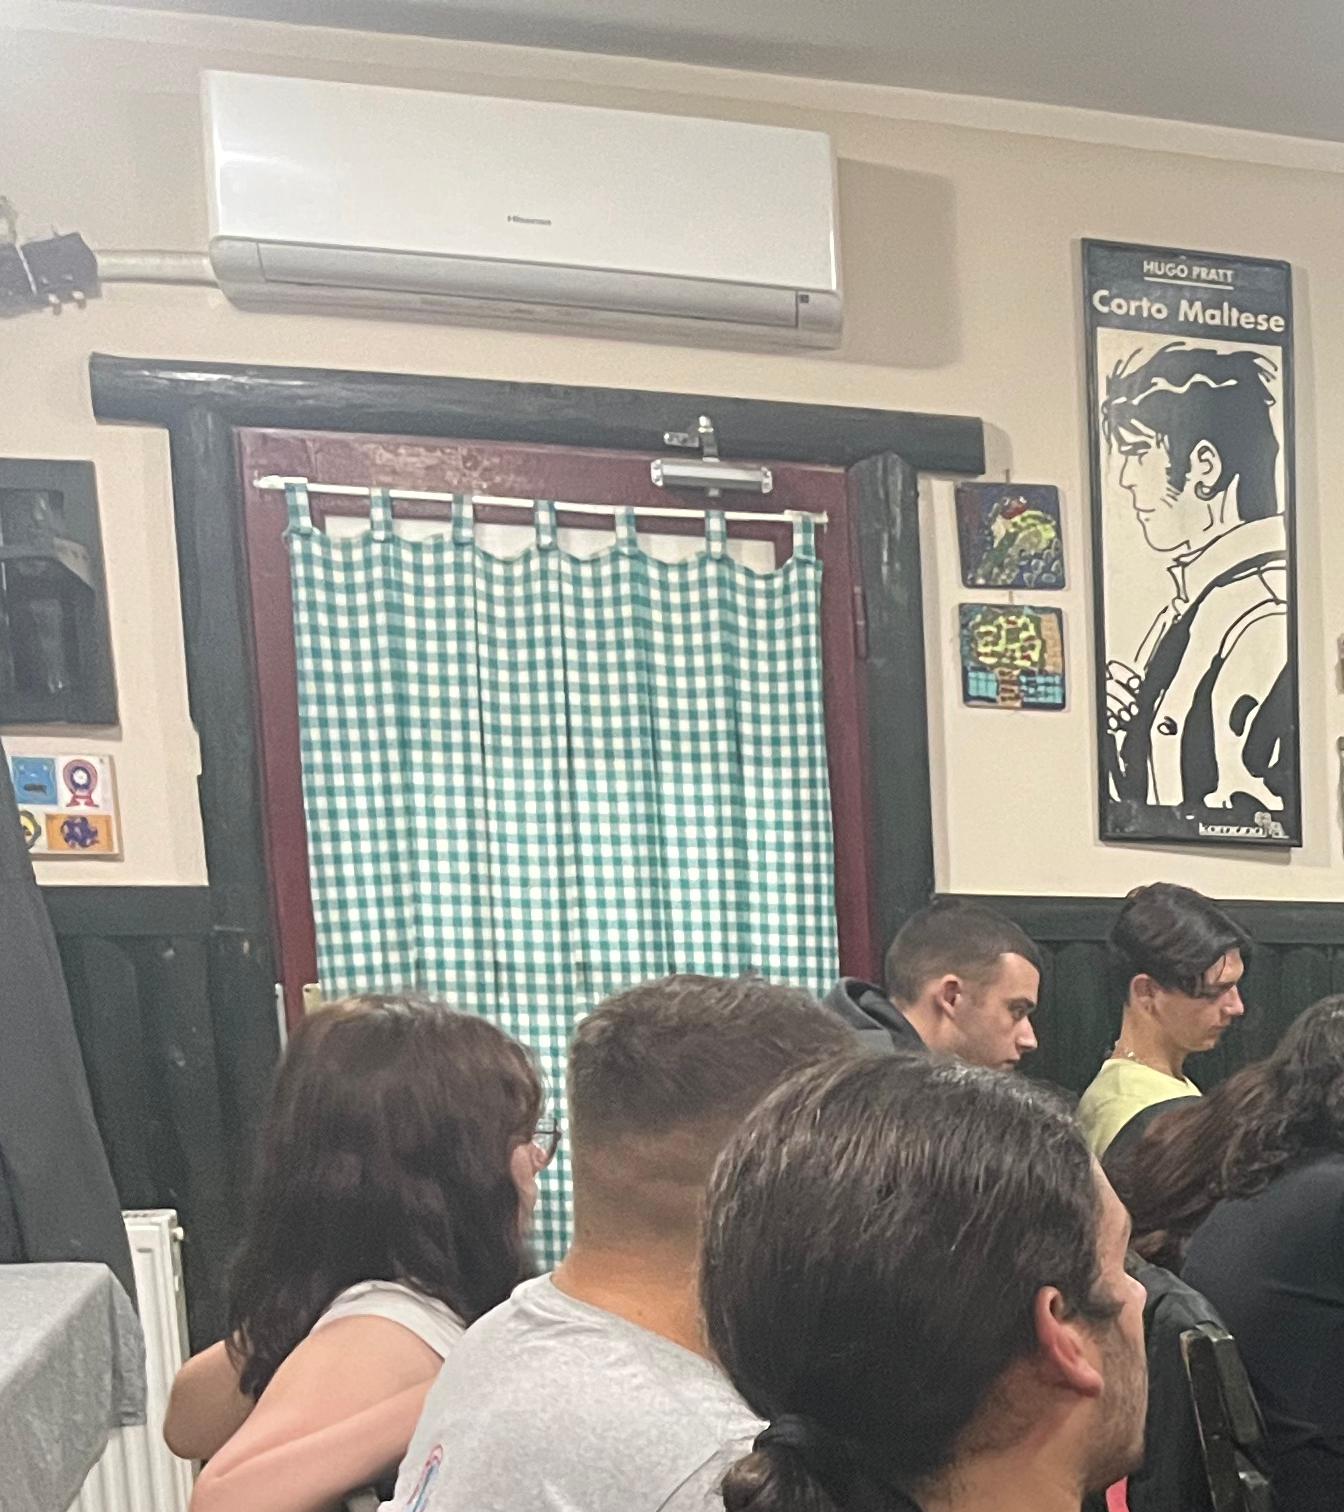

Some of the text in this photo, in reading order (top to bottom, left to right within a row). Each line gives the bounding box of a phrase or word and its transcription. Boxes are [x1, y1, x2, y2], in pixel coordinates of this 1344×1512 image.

[1143, 260, 1235, 283] HUGO PRATT
[1092, 289, 1285, 333] Corto Maltese
